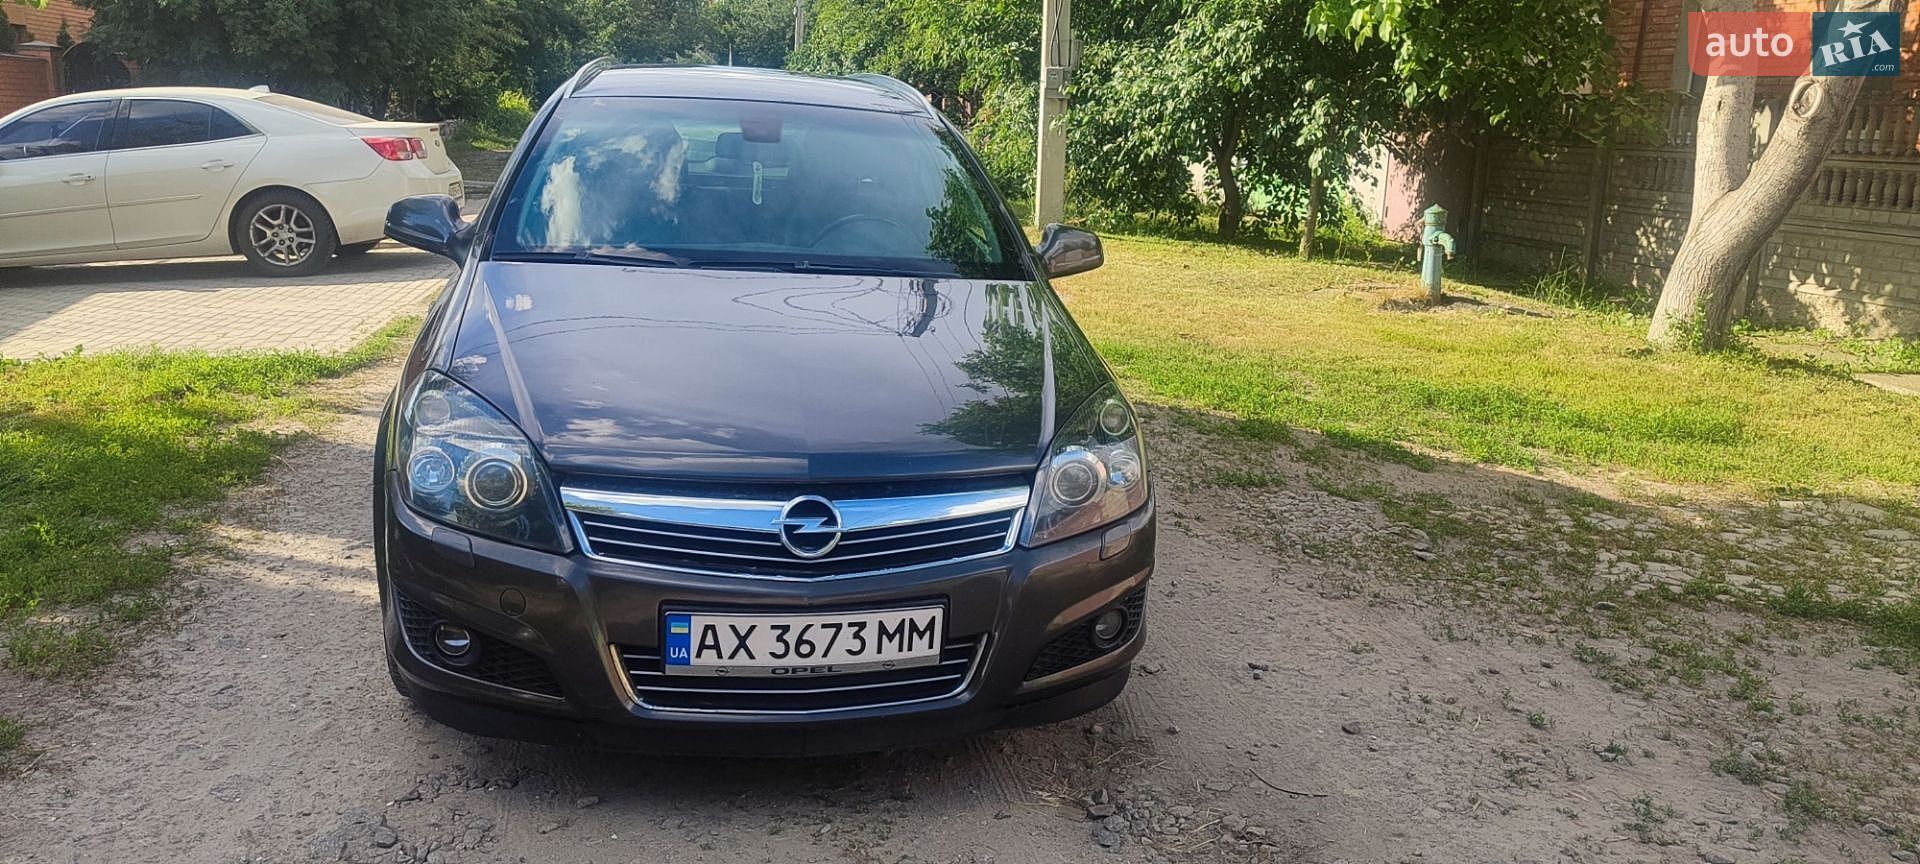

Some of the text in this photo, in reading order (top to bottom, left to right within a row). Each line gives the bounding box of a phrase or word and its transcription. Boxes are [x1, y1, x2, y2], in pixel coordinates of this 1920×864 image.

[695, 615, 936, 660] AX 3673 MM
[670, 647, 688, 659] UA
[770, 665, 843, 675] OPEL
